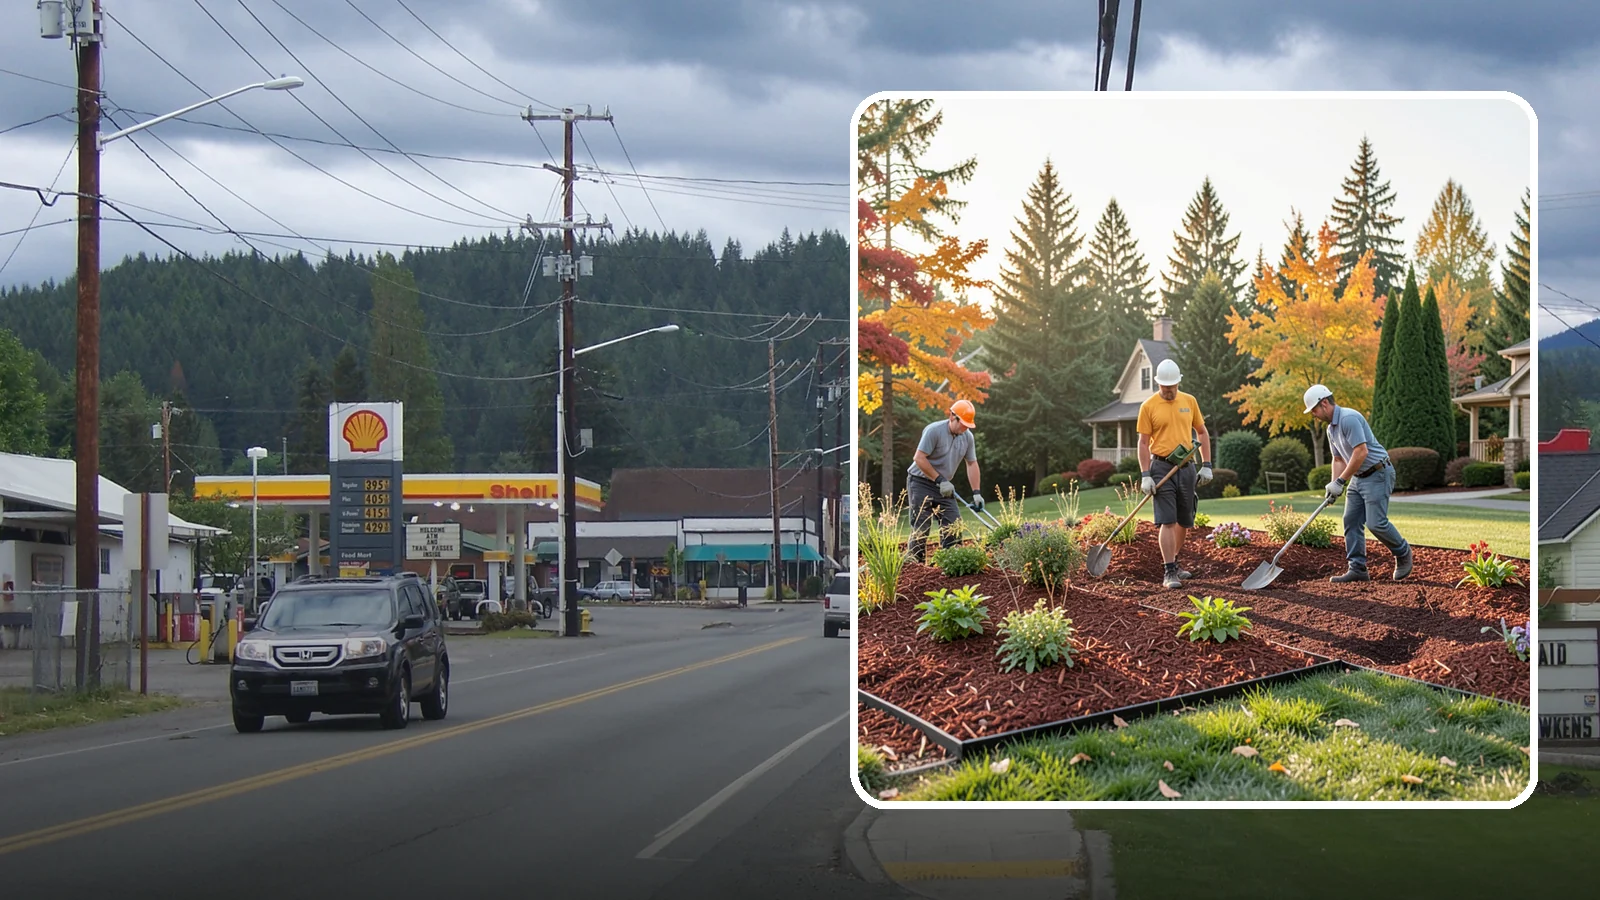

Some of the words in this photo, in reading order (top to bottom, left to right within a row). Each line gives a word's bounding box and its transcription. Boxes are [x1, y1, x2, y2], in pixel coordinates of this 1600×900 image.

[366, 480, 383, 490] 395
[490, 484, 547, 499] Shell
[365, 494, 383, 504] 405
[365, 508, 383, 518] 415
[365, 522, 383, 533] 429
